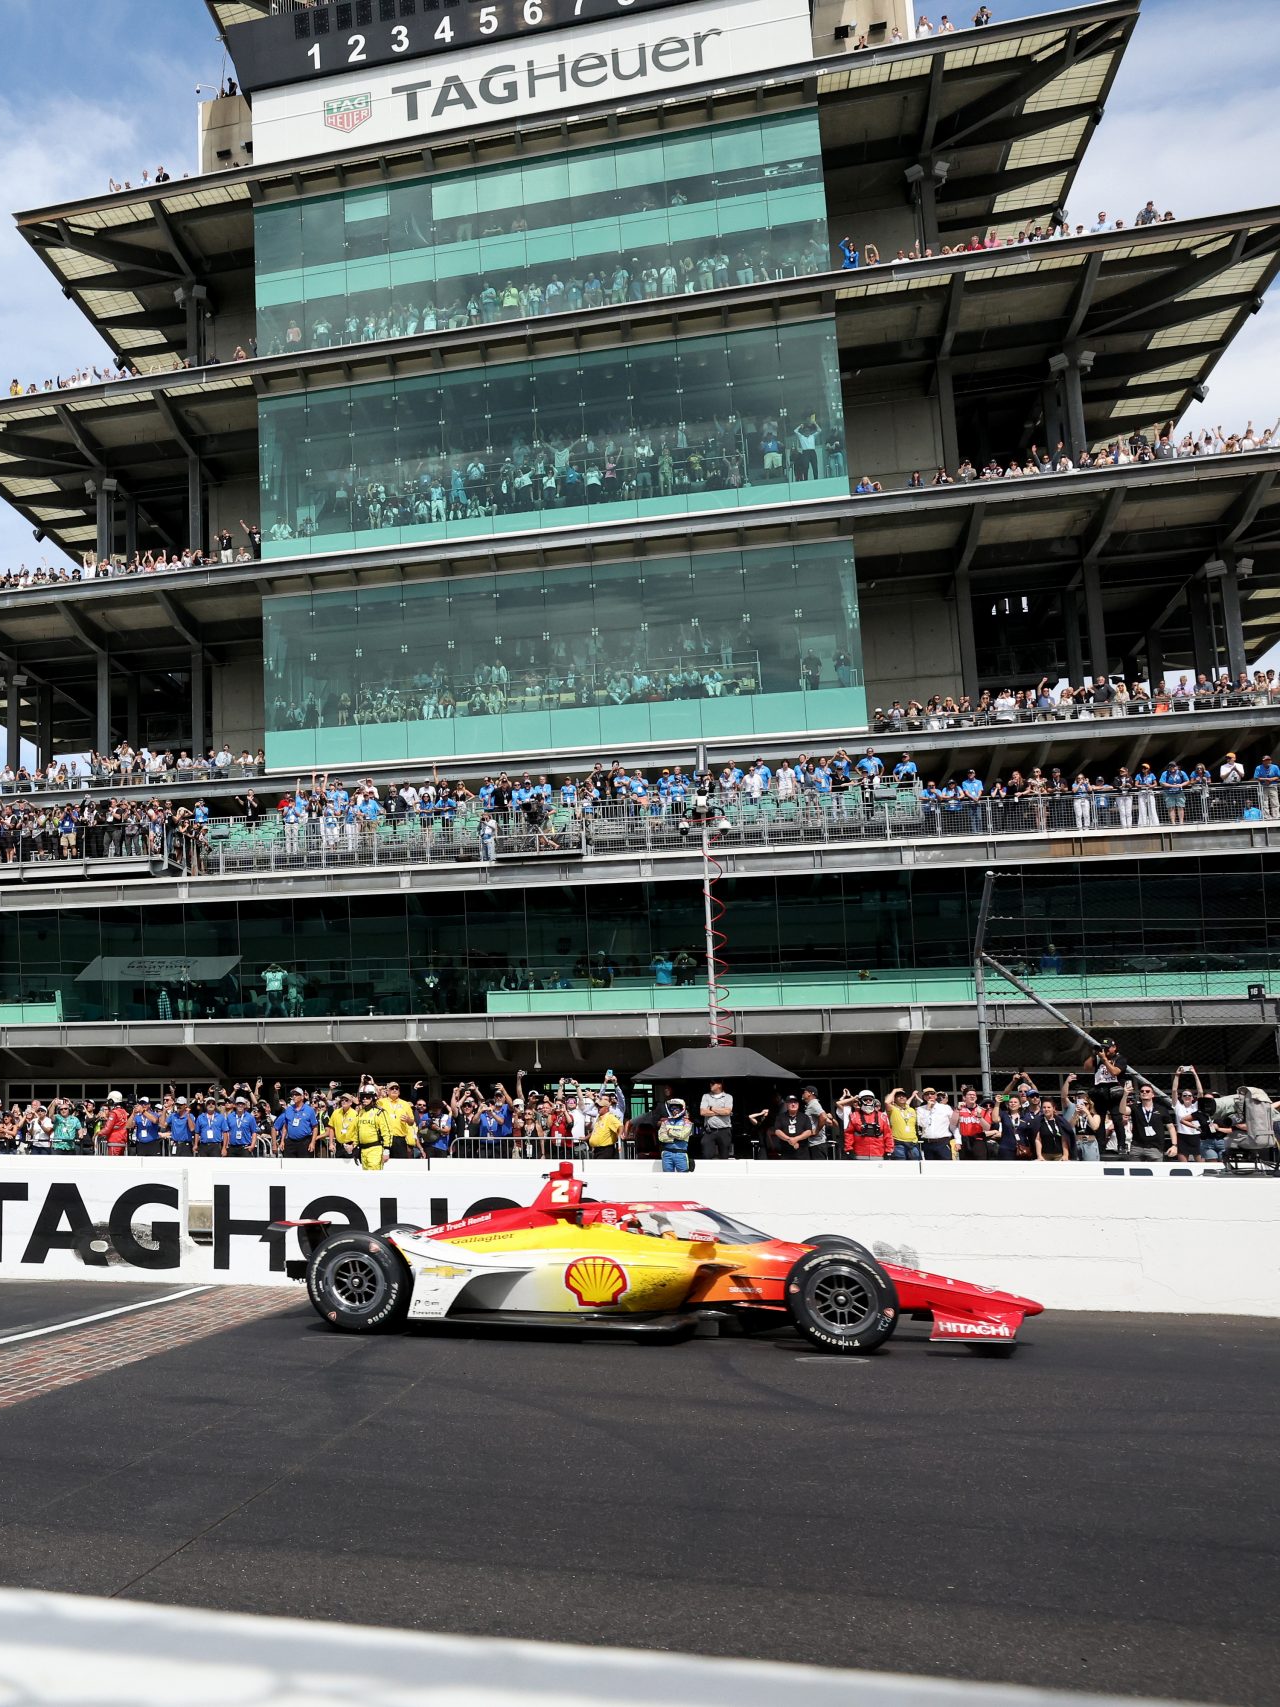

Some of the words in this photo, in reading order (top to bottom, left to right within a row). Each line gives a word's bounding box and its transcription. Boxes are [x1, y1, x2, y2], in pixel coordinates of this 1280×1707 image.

[308, 43, 320, 69] 1
[347, 34, 367, 62] 2
[391, 25, 409, 52] 3
[434, 16, 454, 42] 4
[479, 6, 498, 34] 5
[523, 0, 543, 25] 6
[325, 96, 369, 113] TAG
[327, 109, 370, 131] HEUER
[551, 1180, 569, 1203] 2
[446, 1220, 467, 1231] Truck
[468, 1212, 491, 1226] Rental
[451, 1233, 514, 1245] Gallagher
[367, 1281, 399, 1324] Firestone
[809, 1326, 860, 1347] Firestone
[938, 1321, 1011, 1337] HITACHI
